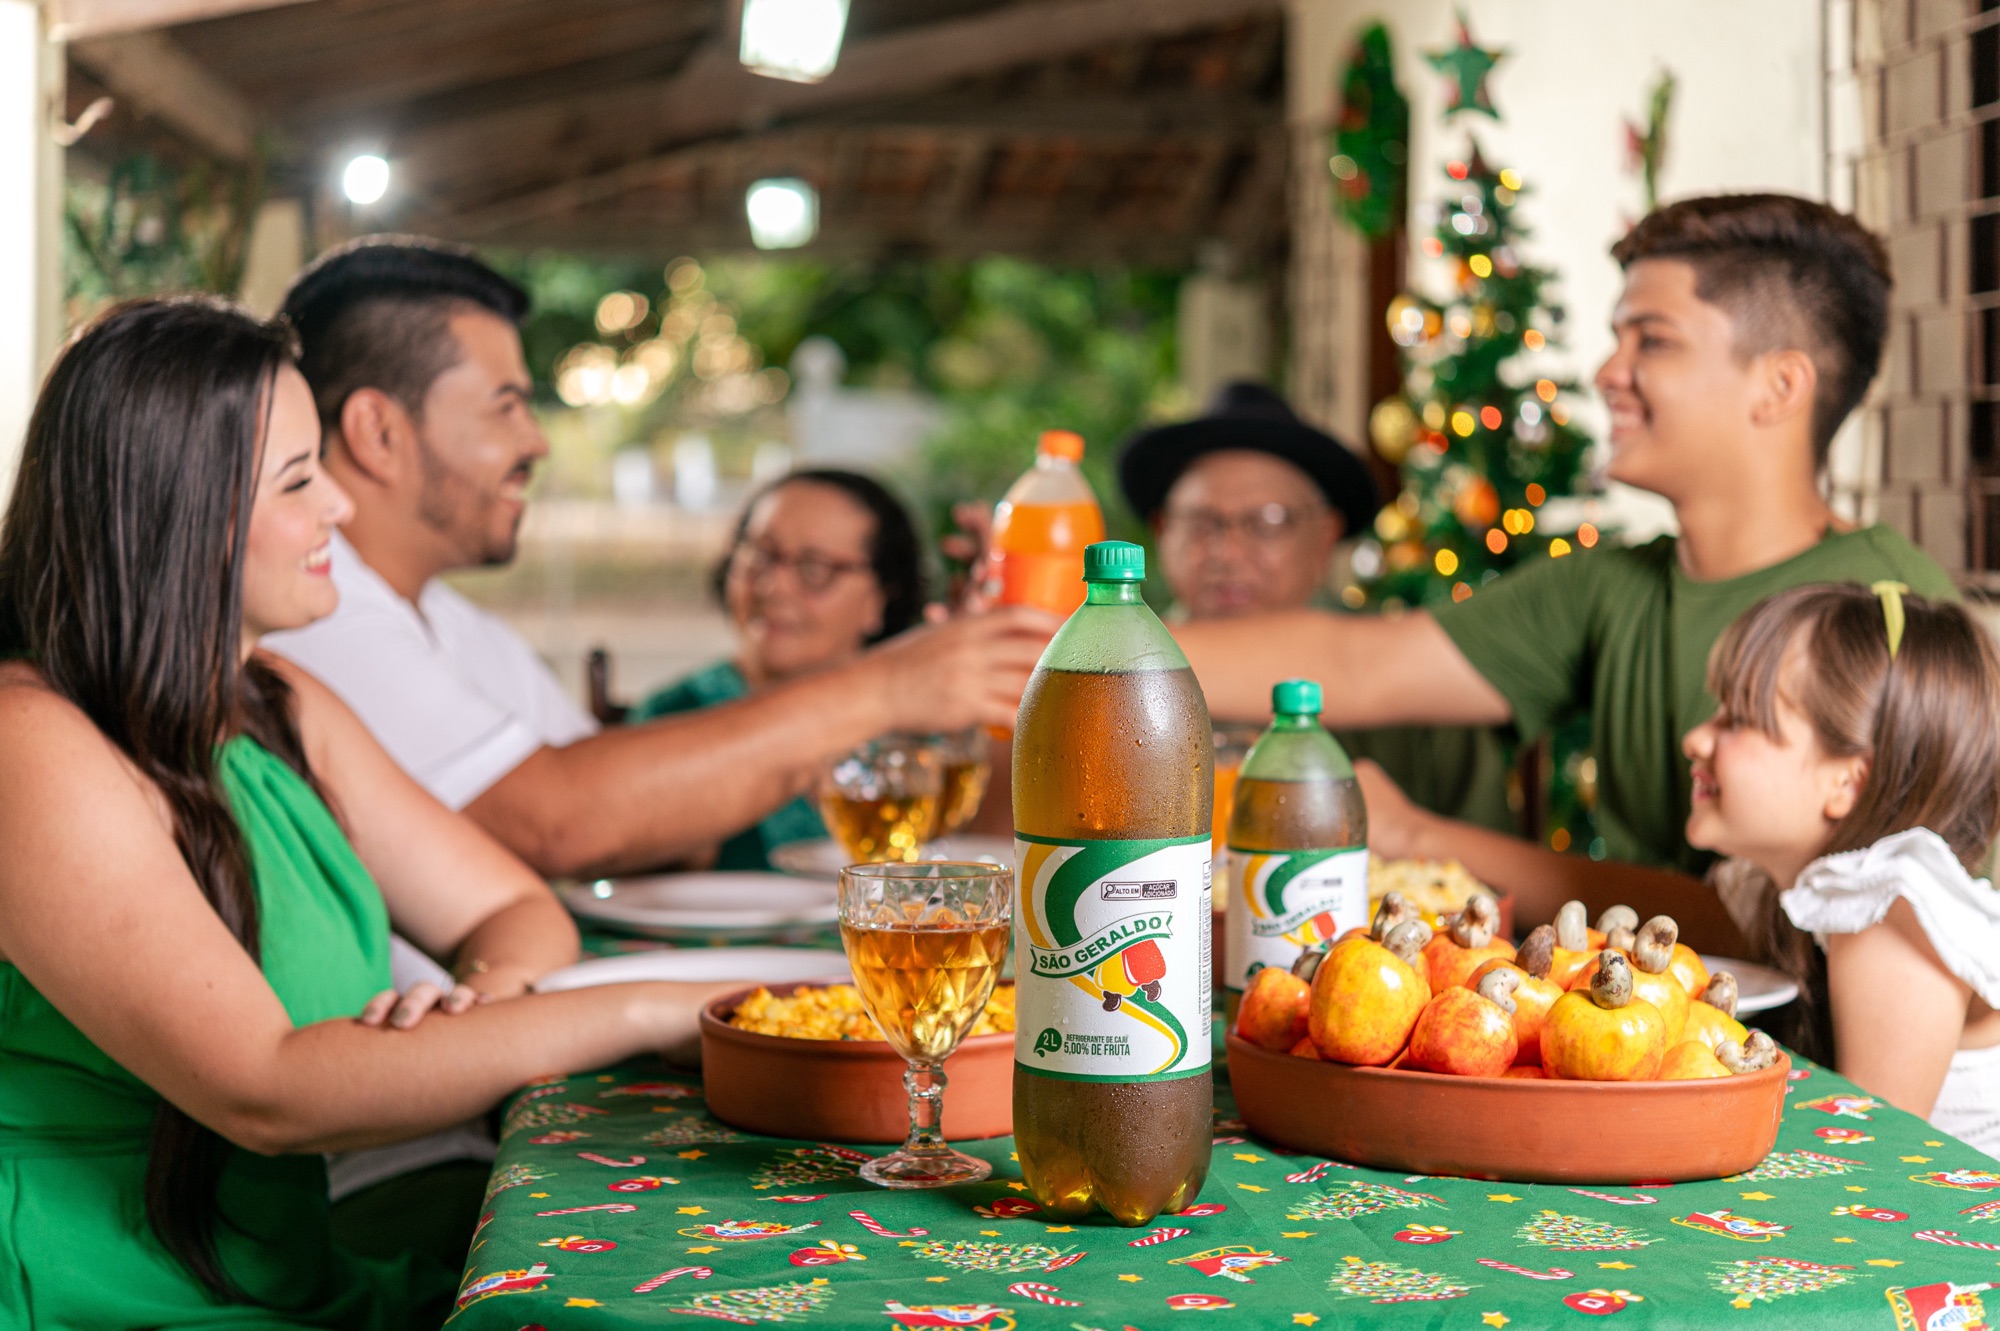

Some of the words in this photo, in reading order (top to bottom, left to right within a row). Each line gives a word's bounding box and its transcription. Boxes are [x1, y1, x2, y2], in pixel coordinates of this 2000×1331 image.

[1039, 953, 1071, 969] SÃO
[1074, 916, 1162, 963] GERALDO
[1043, 1032, 1049, 1046] 2
[1066, 1033, 1105, 1044] REFRIGERANTE
[1063, 1041, 1090, 1056] 5,00%
[1091, 1043, 1102, 1056] DE
[1103, 1043, 1131, 1056] FRUTA
